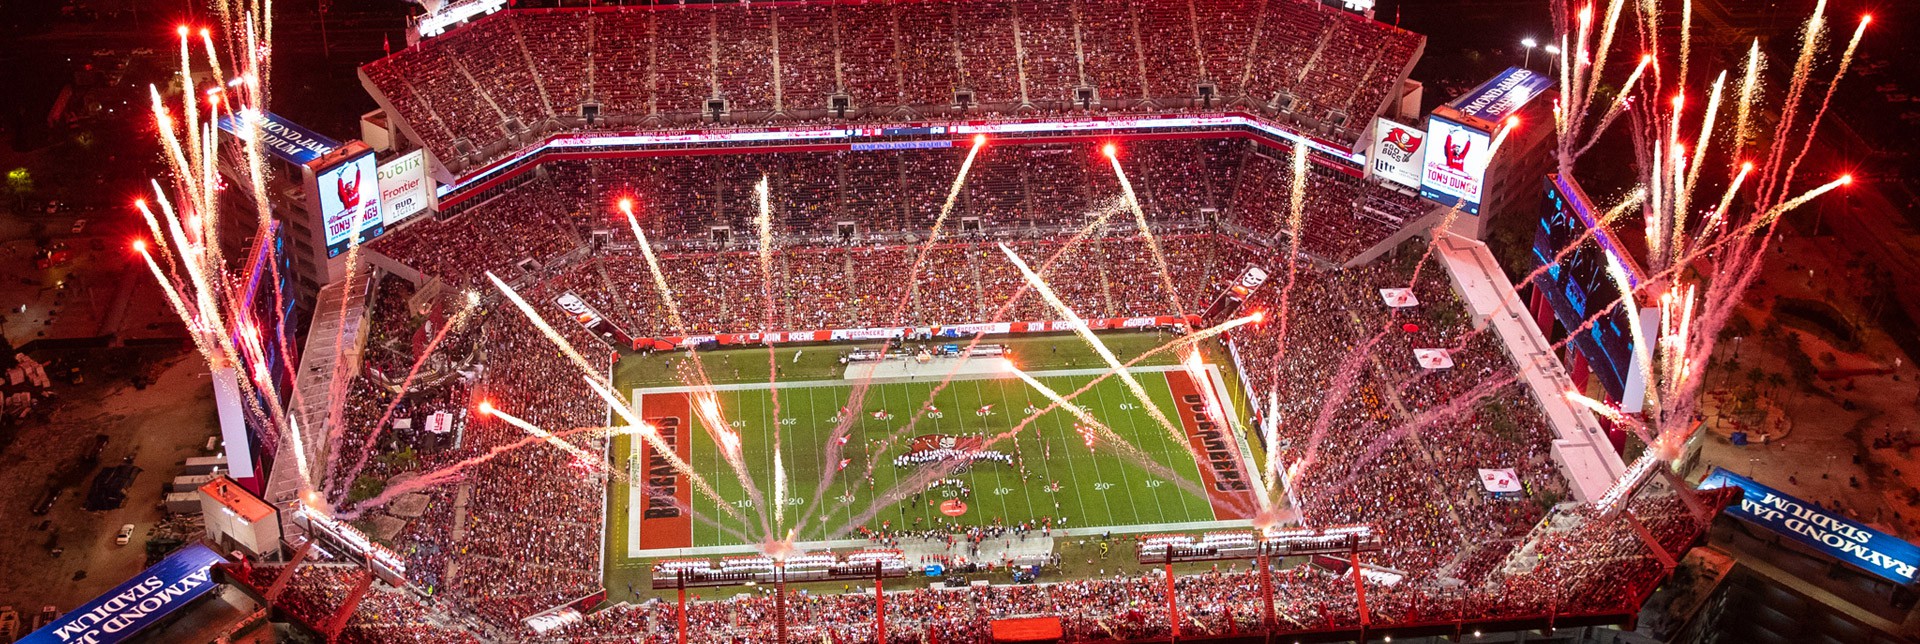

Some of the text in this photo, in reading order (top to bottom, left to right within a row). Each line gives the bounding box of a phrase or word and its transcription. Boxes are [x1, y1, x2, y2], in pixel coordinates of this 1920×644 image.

[892, 142, 916, 150] JAMES
[1382, 148, 1401, 163] BUCS
[1375, 158, 1395, 173] Lite
[1428, 169, 1448, 185] TONY
[383, 177, 420, 201] Frontier
[395, 198, 412, 211] BUD
[393, 203, 416, 219] LIGHT
[329, 216, 351, 237] TONY
[1028, 322, 1044, 331] JOIN
[764, 332, 781, 342] JOIN
[788, 331, 815, 341] KREWE
[846, 330, 884, 338] BUCCANEERS
[1119, 403, 1134, 411] 10
[927, 411, 943, 419] 50
[732, 420, 747, 428] 10
[781, 417, 797, 425] 20
[1094, 482, 1110, 491] 20
[1145, 480, 1160, 488] 10
[942, 490, 958, 498] 50
[993, 487, 1009, 496] 40
[737, 500, 753, 508] 10
[788, 497, 804, 506] 20
[1760, 492, 1873, 544] STADIUM
[1784, 517, 1919, 579] RAYMOND
[52, 575, 164, 642] STADIUM
